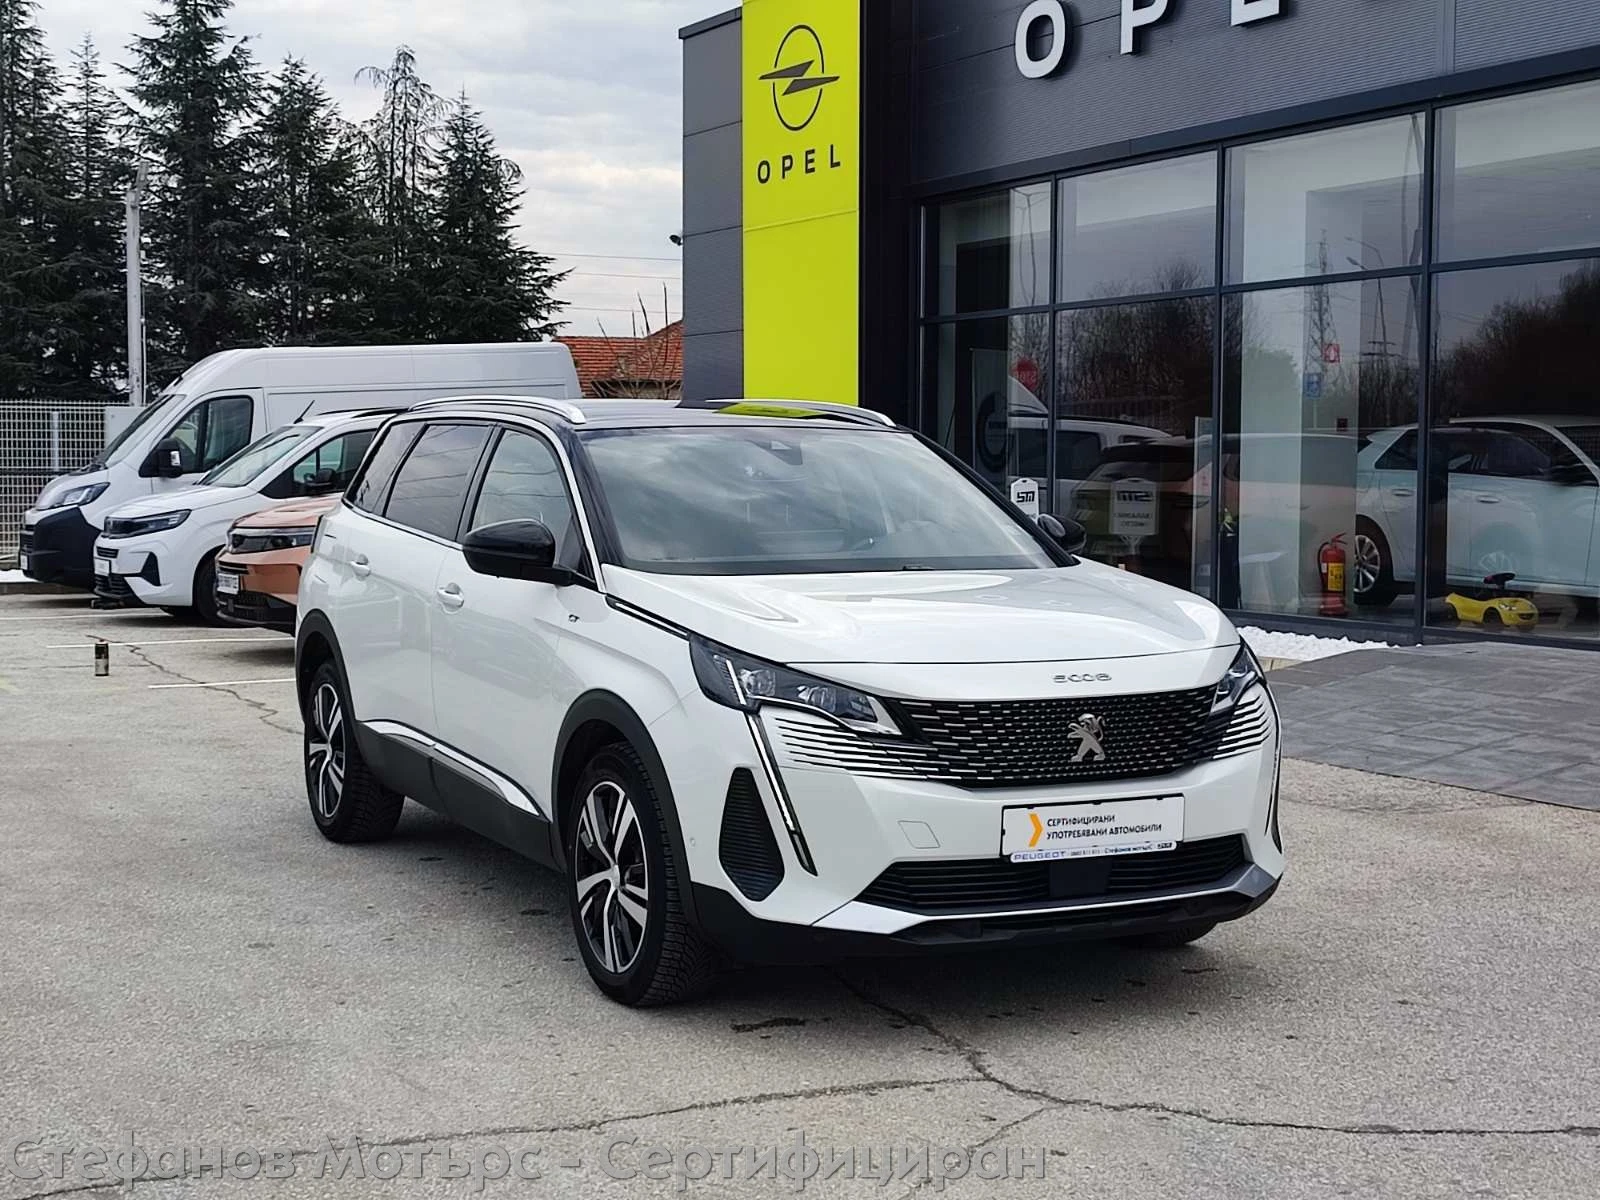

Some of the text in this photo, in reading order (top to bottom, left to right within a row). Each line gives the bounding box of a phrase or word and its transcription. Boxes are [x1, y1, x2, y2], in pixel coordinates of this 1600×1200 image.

[757, 144, 841, 184] OPEL
[1047, 814, 1115, 827] СЕРТИФИЦИРАНИ
[1046, 824, 1162, 840] УПОТРЕБЯВАНИ АВТОМОБИЛИ
[1014, 850, 1066, 860] PEUGEOT
